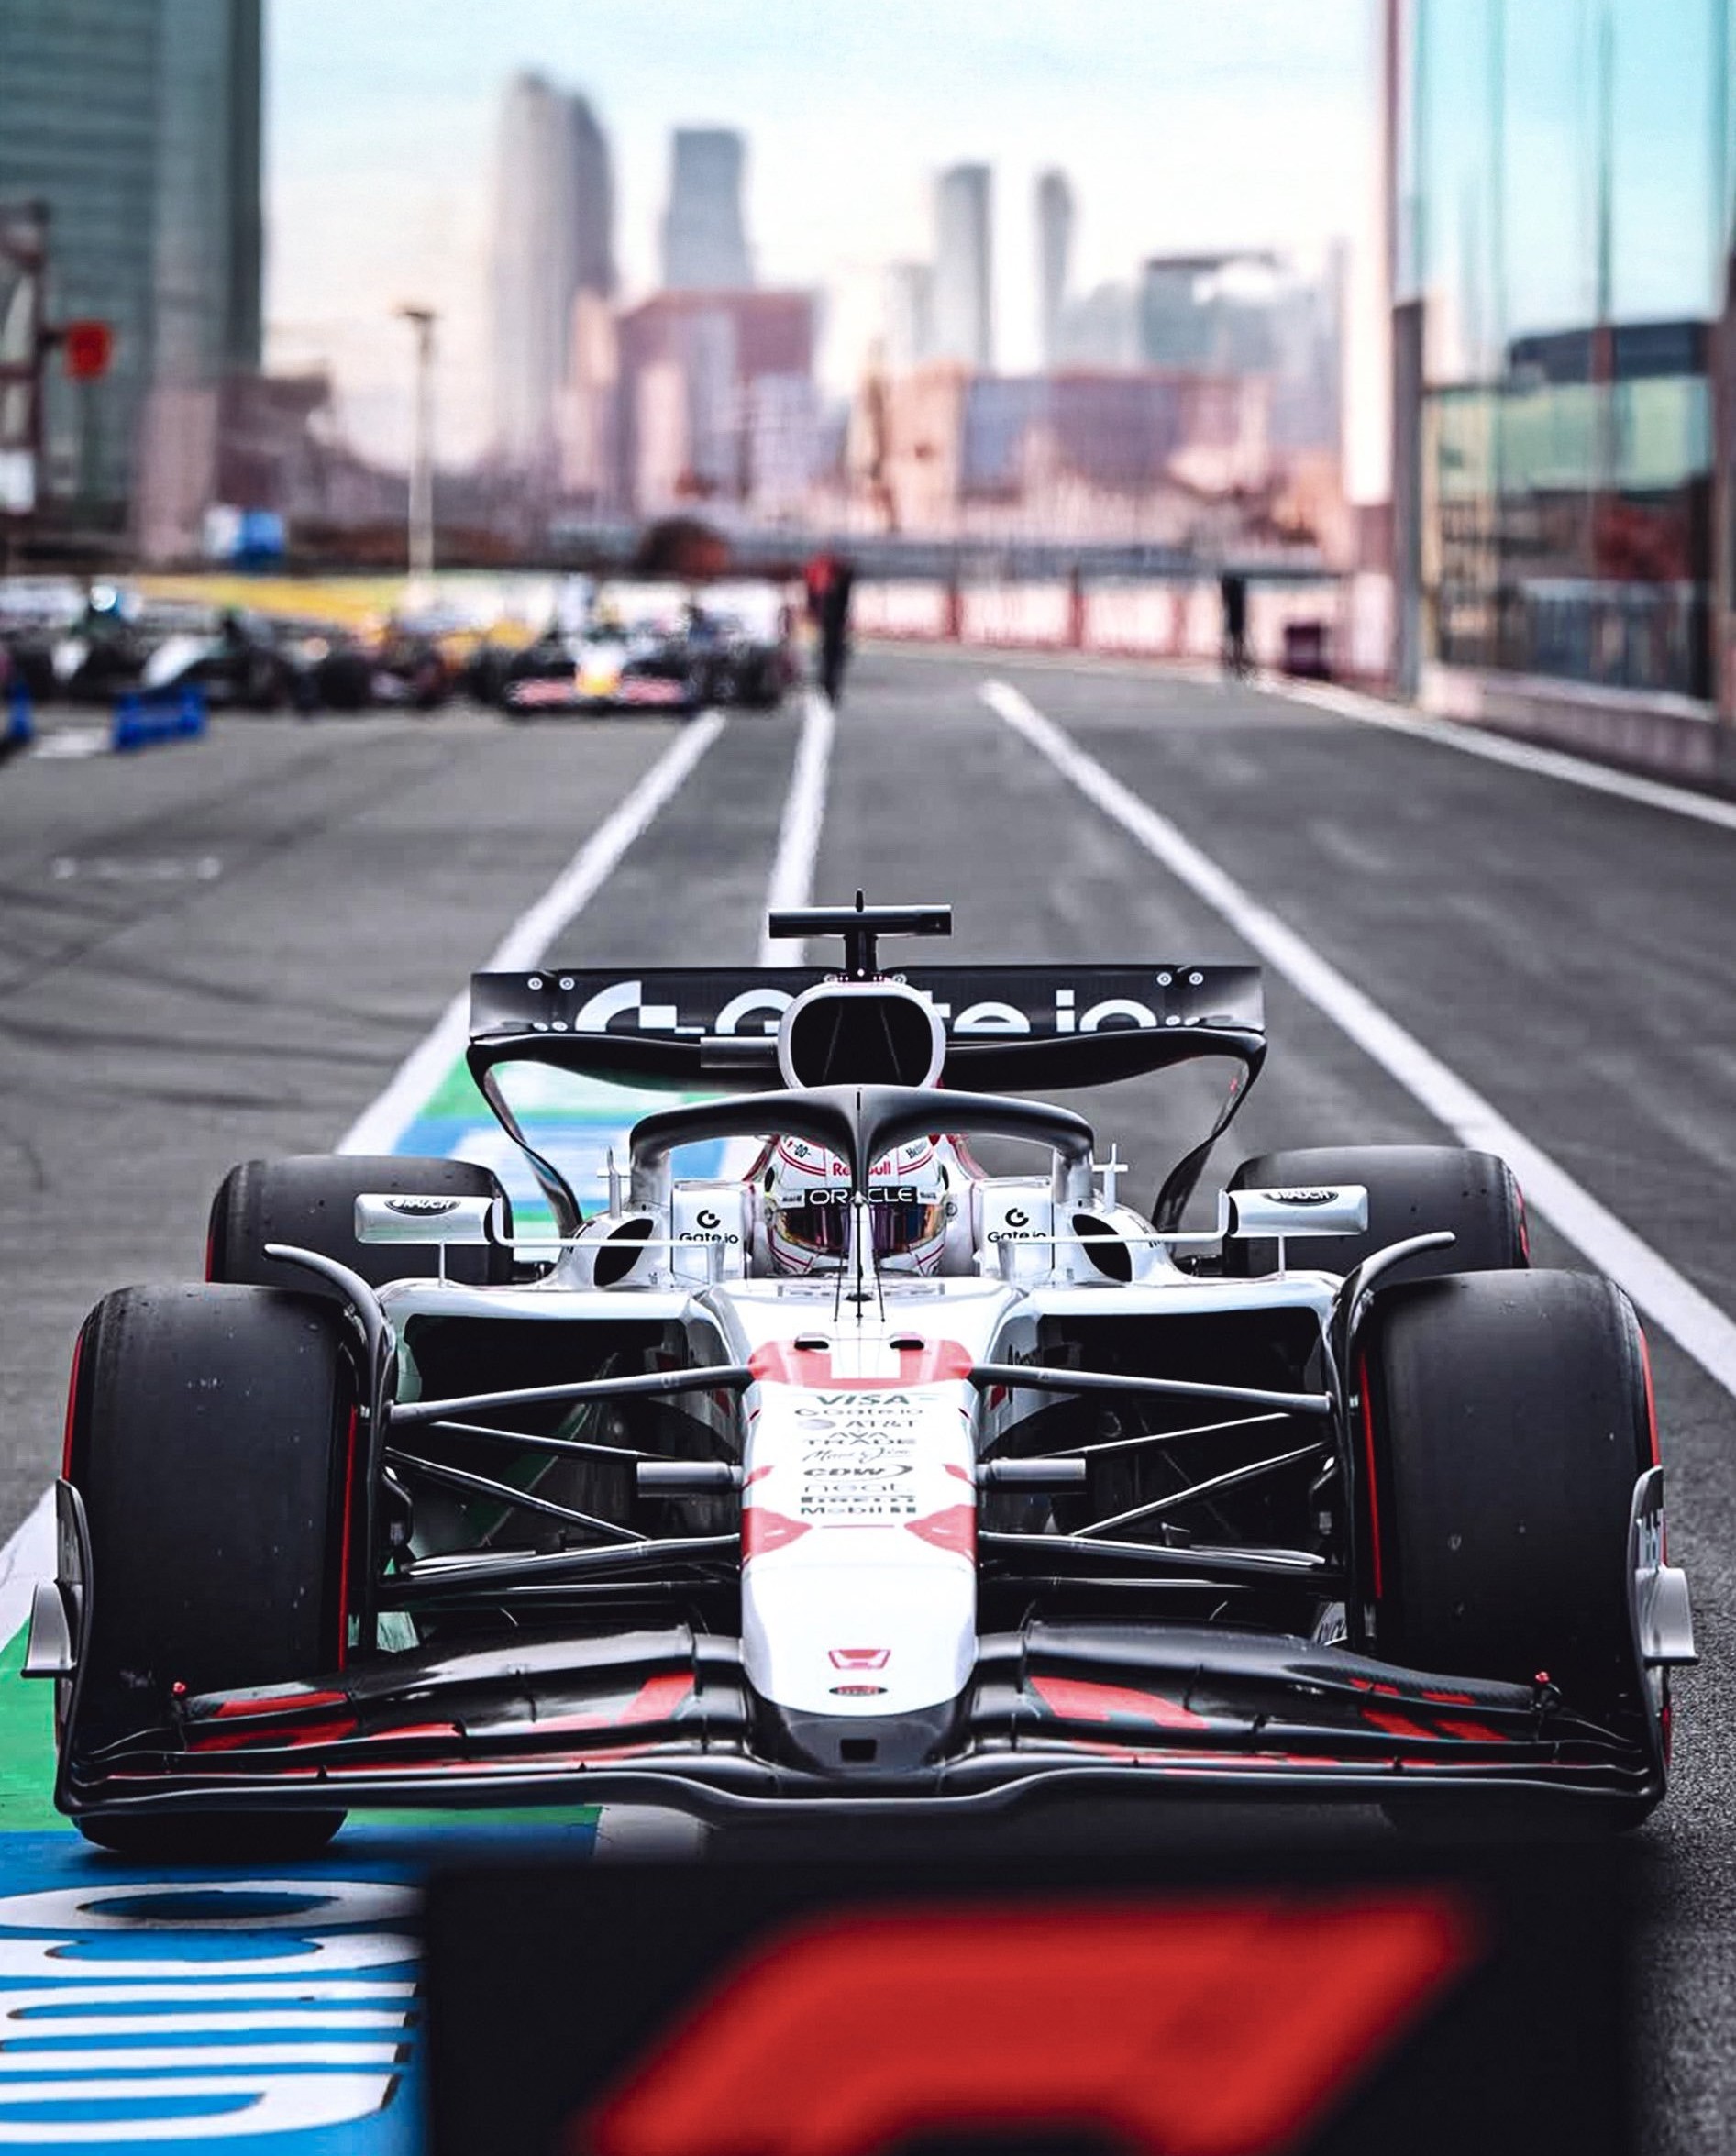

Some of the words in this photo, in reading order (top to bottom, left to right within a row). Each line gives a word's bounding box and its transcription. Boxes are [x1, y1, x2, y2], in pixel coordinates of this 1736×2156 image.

[833, 1162, 853, 1177] Re
[868, 1161, 891, 1176] ull
[809, 1188, 913, 1205] ORCLE
[816, 1394, 911, 1406] VISA
[824, 1408, 923, 1417] Gateio
[803, 1467, 886, 1476] CDW
